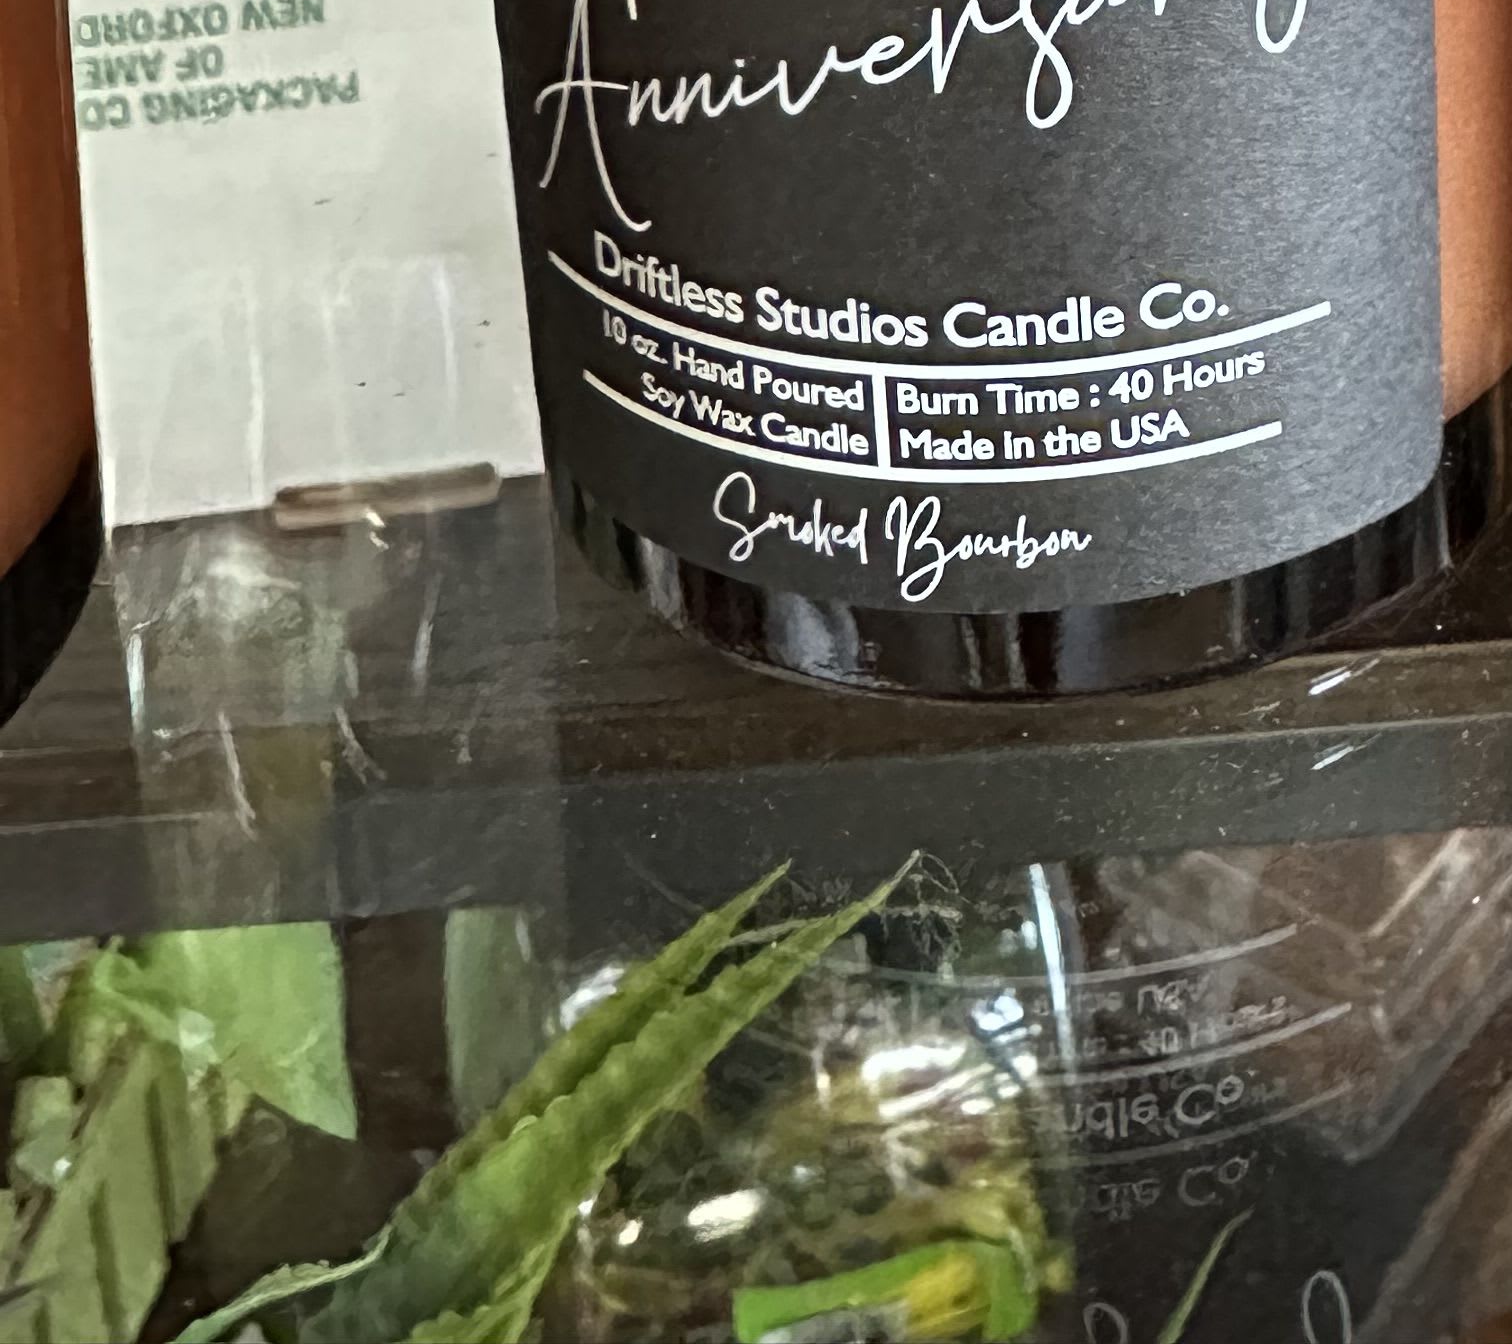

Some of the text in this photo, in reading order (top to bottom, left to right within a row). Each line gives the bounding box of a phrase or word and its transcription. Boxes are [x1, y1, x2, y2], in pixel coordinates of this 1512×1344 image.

[76, 2, 229, 47] OXFORD
[176, 44, 225, 81] OF
[140, 69, 362, 125] PACKAGING
[594, 230, 1230, 348] Driftless Studios Candle Co.
[603, 309, 865, 412] 10 oz. Hand Poured
[896, 382, 979, 416] Burn
[985, 382, 1080, 415] Time
[1107, 368, 1154, 404] 40
[1162, 350, 1266, 396] Hours
[640, 371, 870, 456] Soy Wax Candle
[899, 408, 1191, 461] Made in the USA
[713, 471, 1093, 603] Smoked Bourbon
